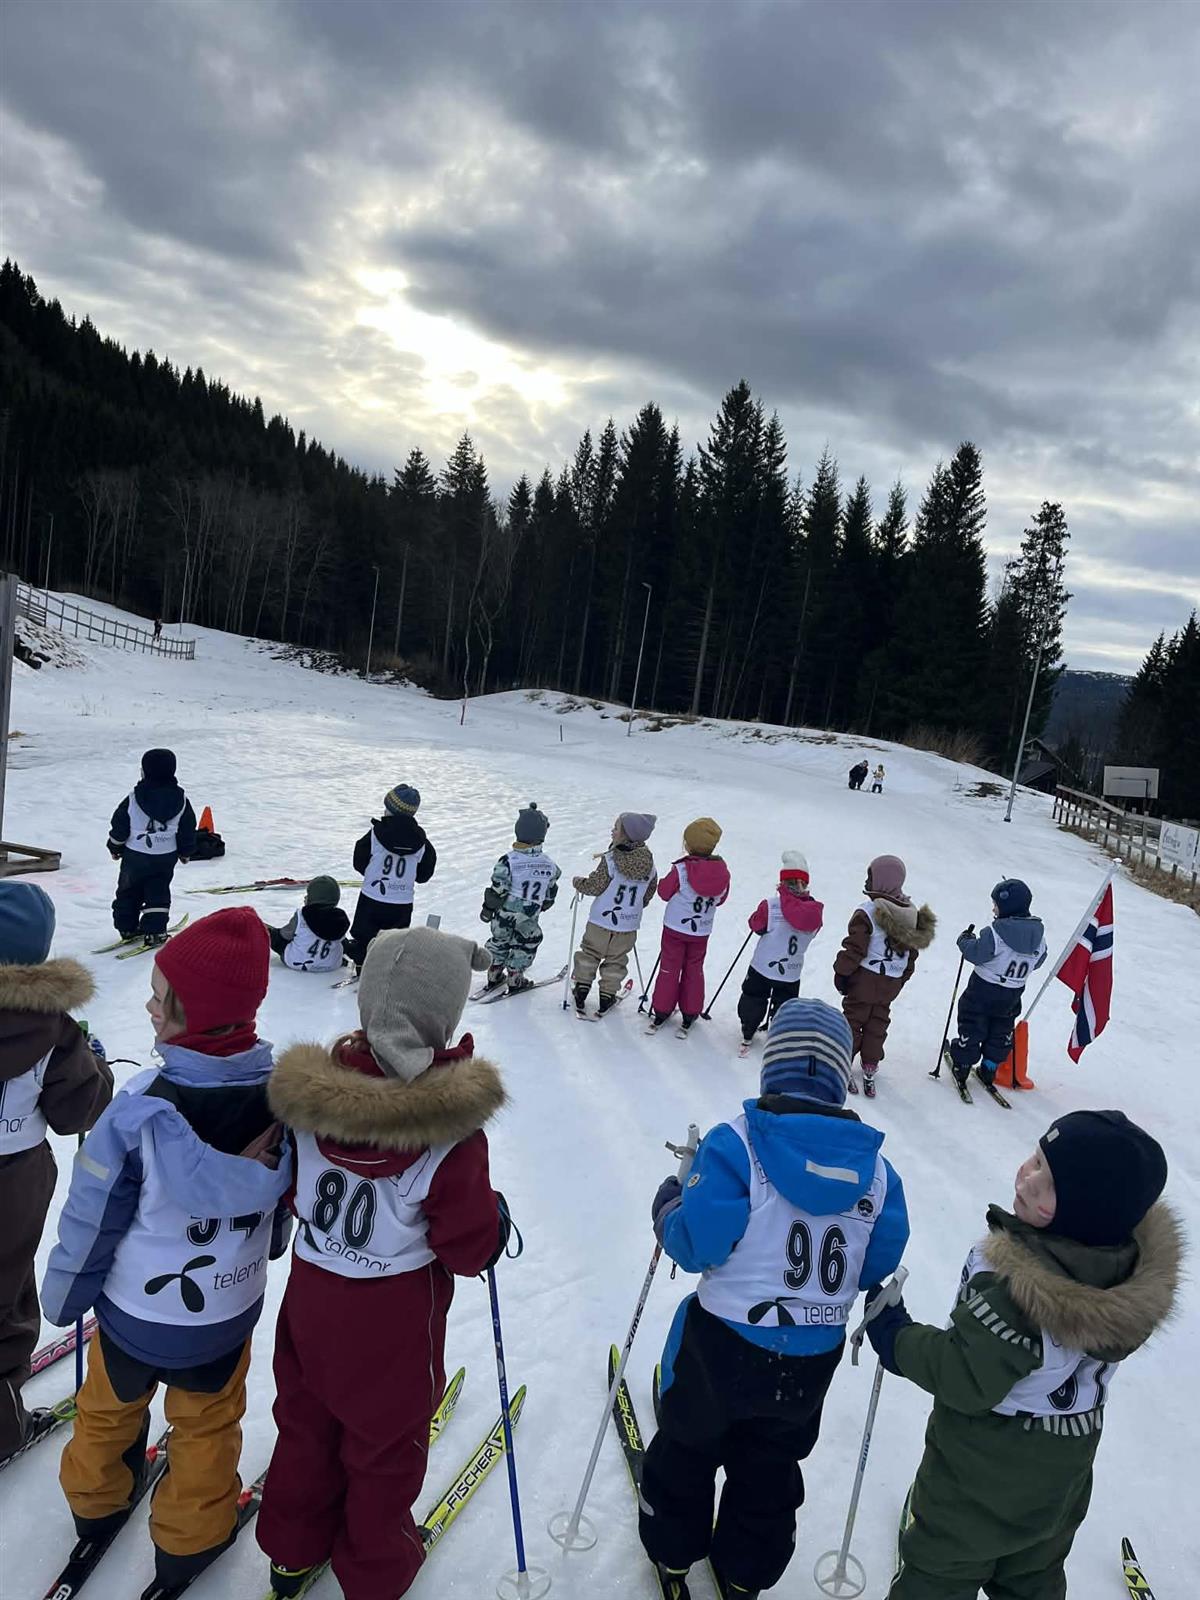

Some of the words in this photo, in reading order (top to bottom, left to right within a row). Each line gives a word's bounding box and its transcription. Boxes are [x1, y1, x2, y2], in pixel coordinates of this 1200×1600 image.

[382, 855, 406, 878] 90
[521, 881, 542, 900] 12
[613, 885, 638, 906] 51
[307, 939, 332, 960] 46
[788, 935, 798, 956] 6
[312, 1168, 377, 1249] 80
[783, 1219, 848, 1296] 96
[616, 1386, 642, 1451] FISCHER
[447, 1447, 497, 1511] FISCHER
